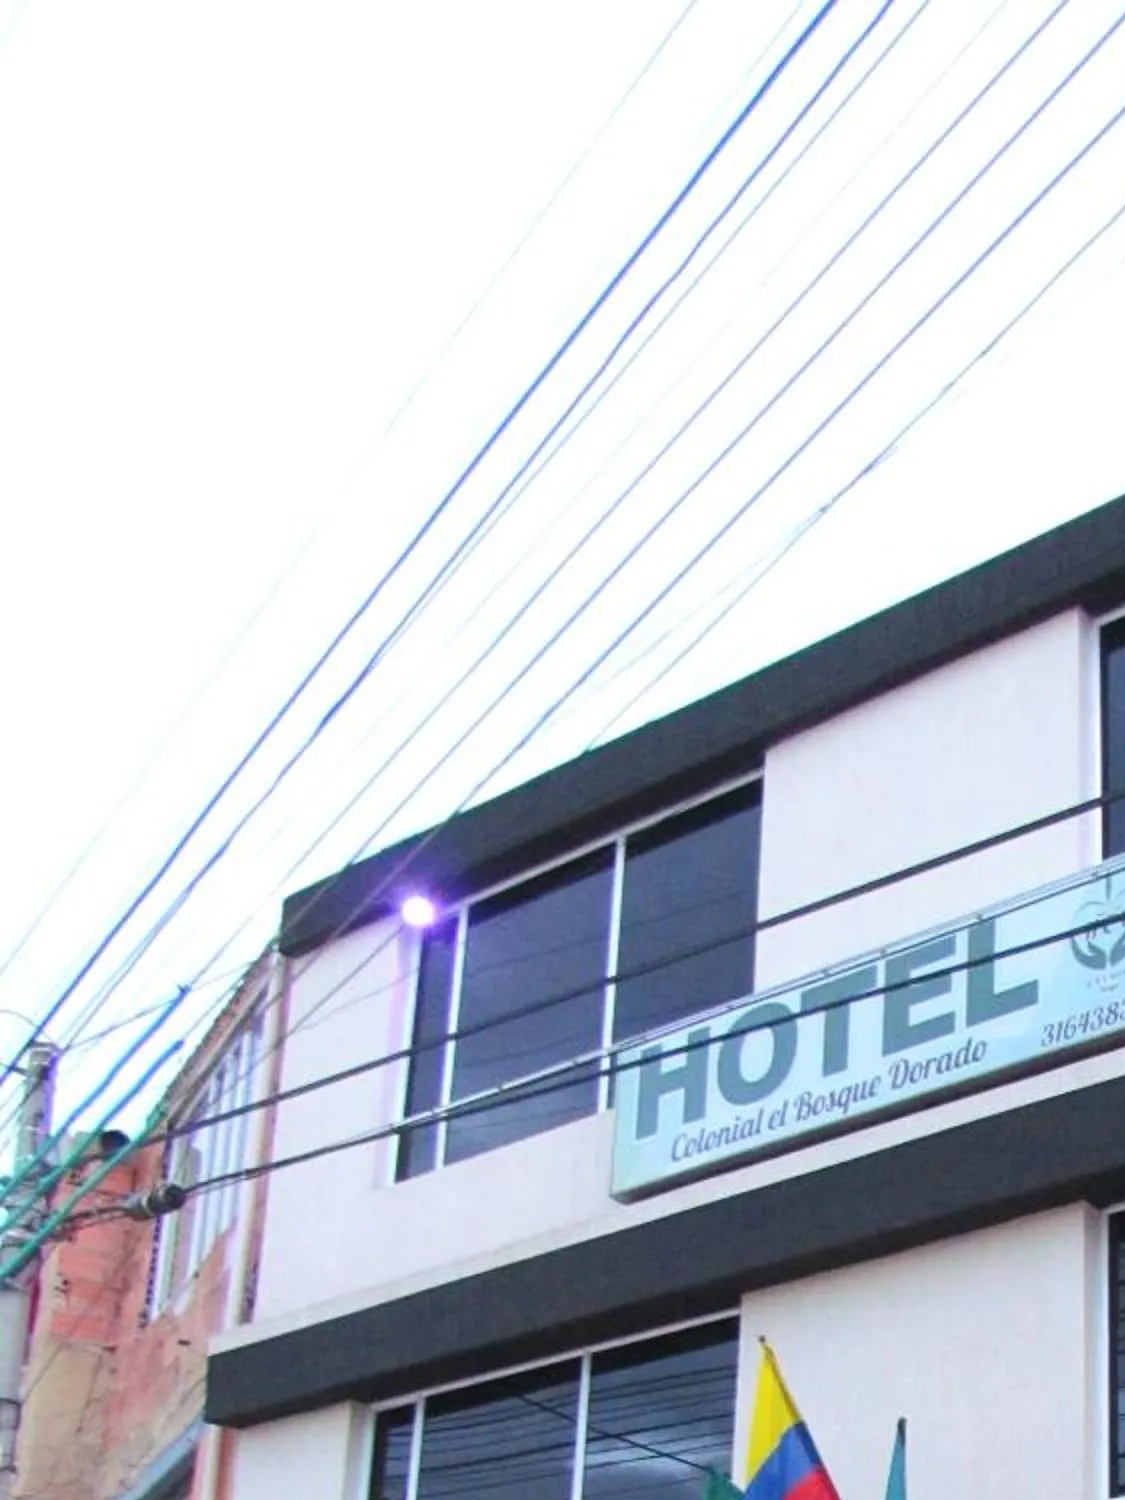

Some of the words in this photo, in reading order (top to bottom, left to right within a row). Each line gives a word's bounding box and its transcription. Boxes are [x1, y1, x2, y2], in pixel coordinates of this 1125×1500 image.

[635, 919, 1039, 1140] HOTEL
[671, 1112, 764, 1163] Colonial
[768, 1101, 789, 1131] el
[792, 1077, 881, 1123] Bosque
[888, 1037, 988, 1091] Dorado
